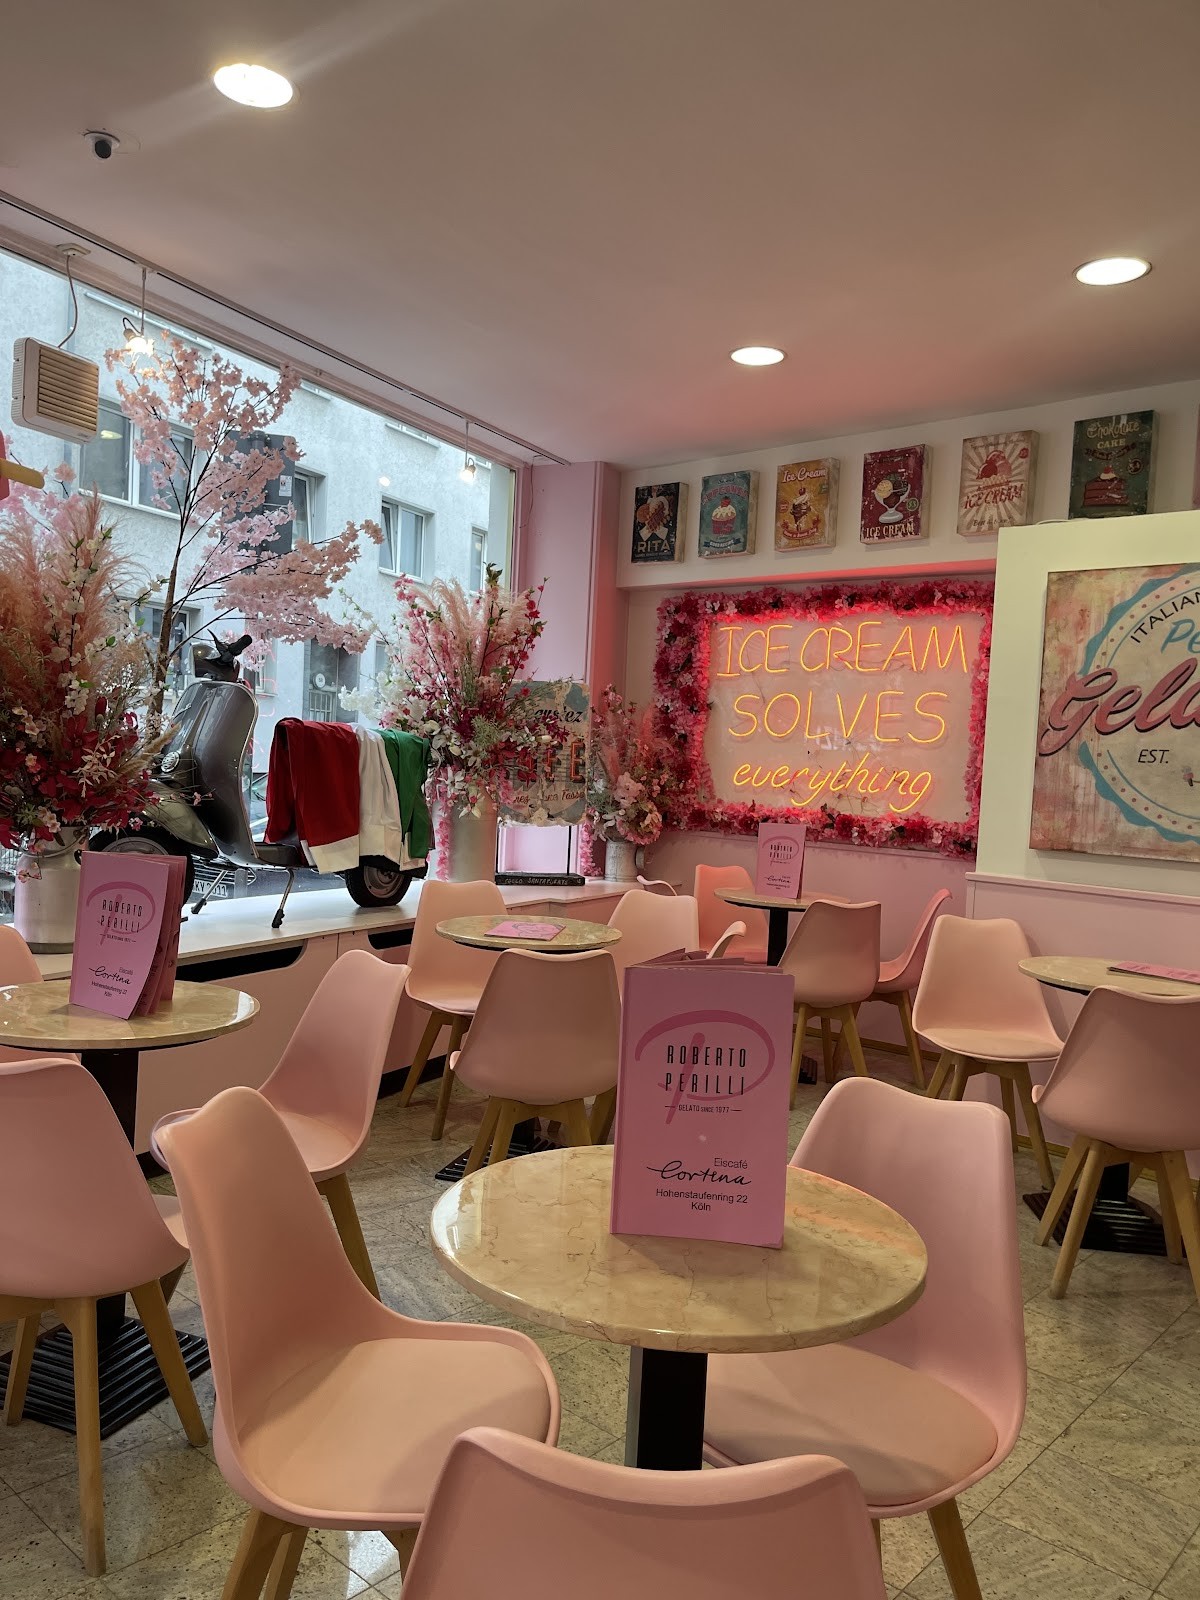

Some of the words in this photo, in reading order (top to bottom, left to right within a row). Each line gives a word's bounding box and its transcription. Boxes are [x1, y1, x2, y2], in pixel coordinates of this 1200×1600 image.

[1097, 438, 1126, 449] CAKE
[781, 471, 797, 483] Ice
[797, 467, 828, 481] Cream
[866, 527, 881, 538] ICE
[882, 521, 915, 537] CREAM
[637, 539, 671, 553] RITA
[716, 623, 793, 677] ICE
[799, 621, 968, 673] CREAM
[728, 690, 948, 743] SOLVES
[1138, 749, 1170, 764] EST.
[732, 752, 932, 813] everything
[102, 899, 143, 917] ROBERTO
[667, 1045, 746, 1067] ROBERTO
[665, 1072, 744, 1095] PERILLI
[678, 1104, 700, 1112] GELATO
[715, 1106, 730, 1114] 1977
[714, 1157, 748, 1169] Eiscafé
[656, 1188, 734, 1204] Hohenstaufenring
[736, 1195, 748, 1204] 22
[691, 1202, 711, 1211] Köln
